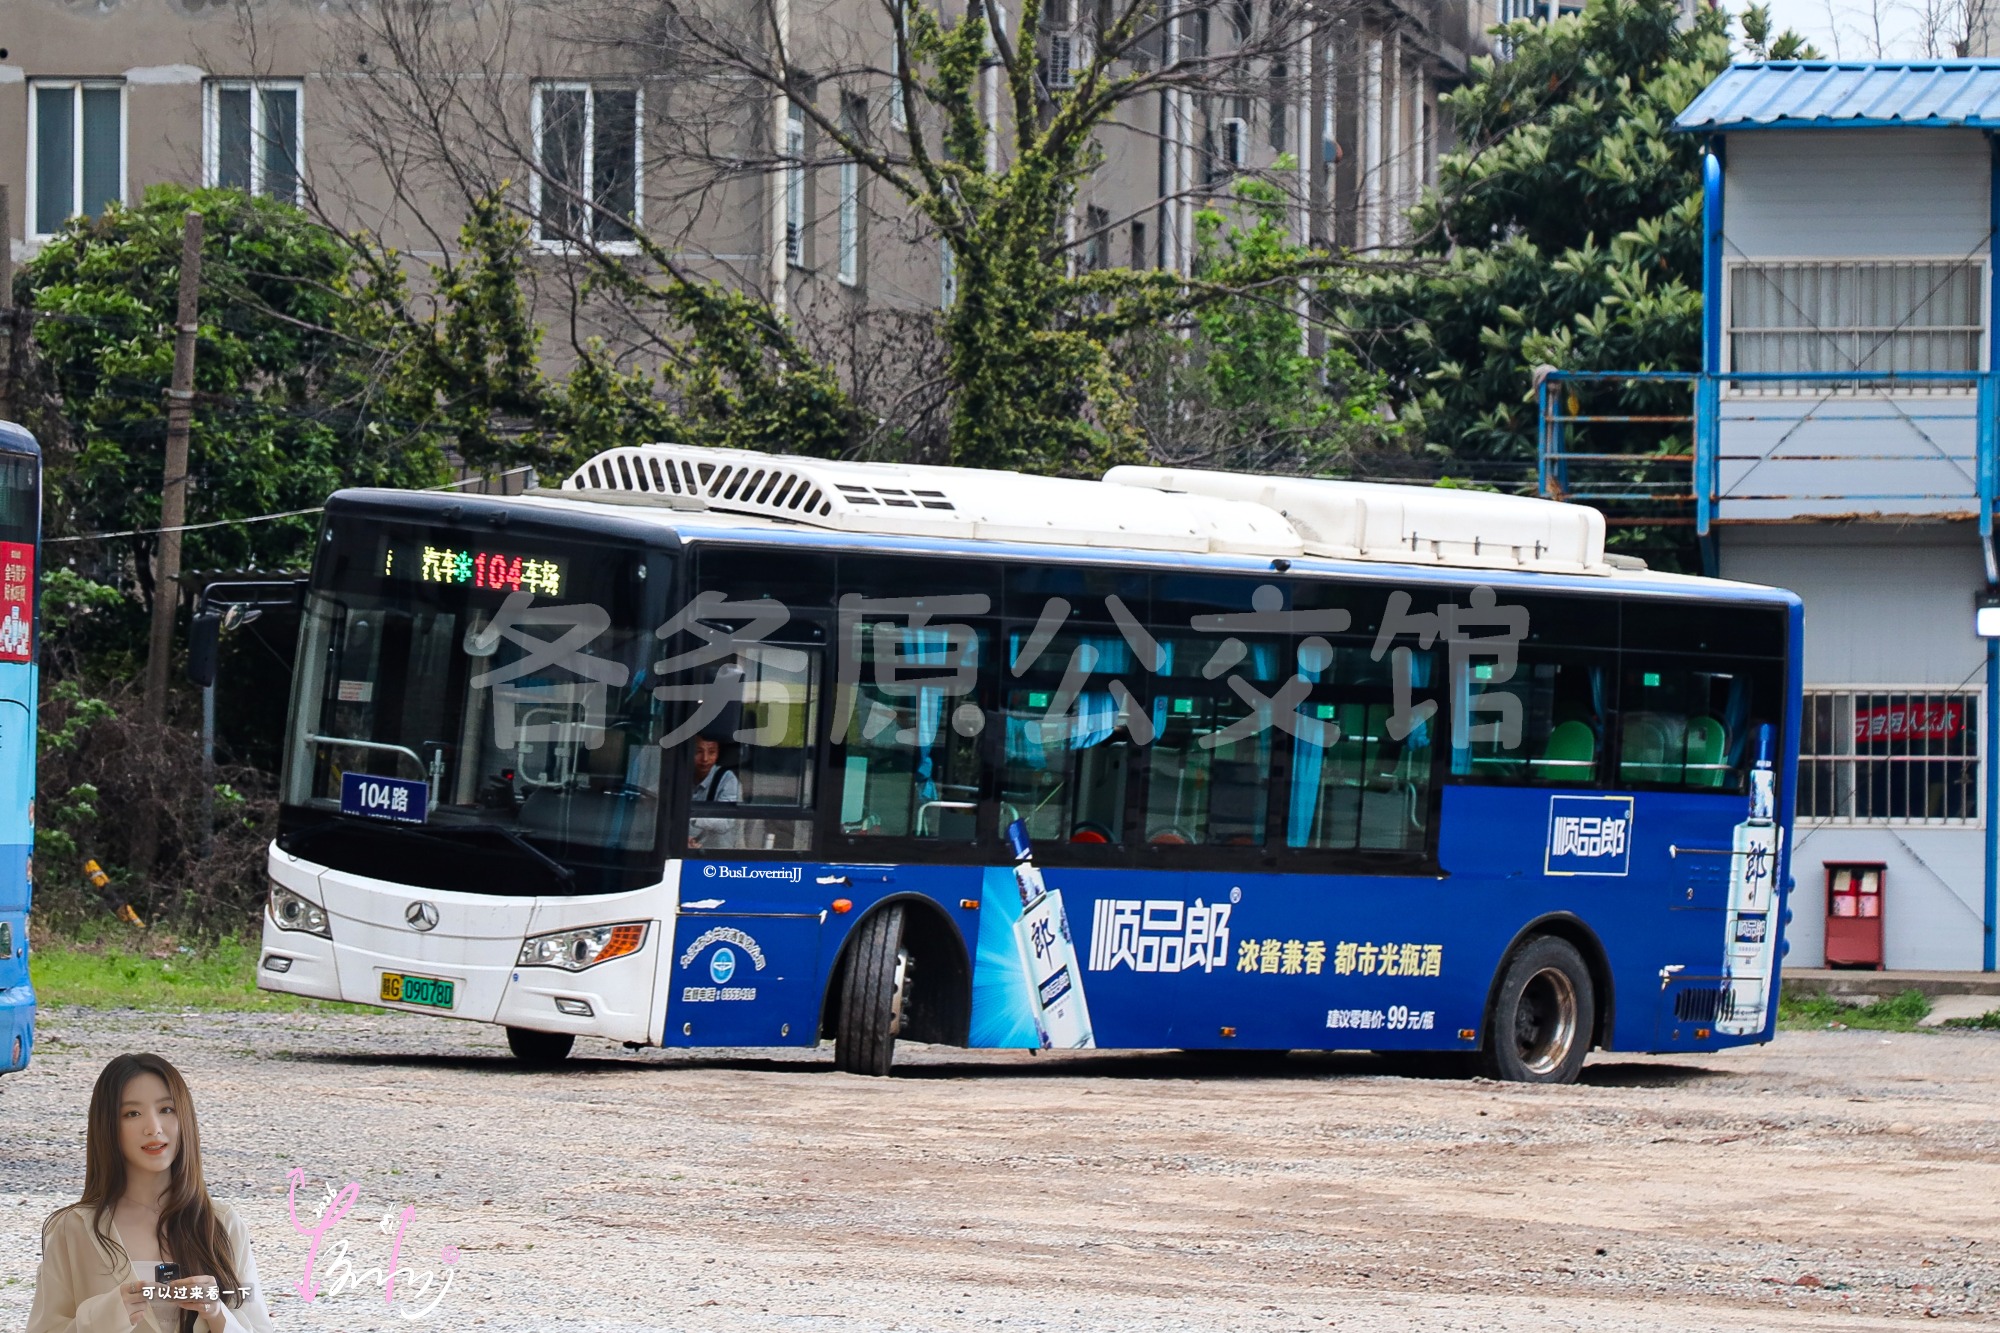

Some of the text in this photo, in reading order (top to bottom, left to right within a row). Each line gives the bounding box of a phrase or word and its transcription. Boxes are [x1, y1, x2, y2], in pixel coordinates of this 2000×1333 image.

[358, 781, 408, 812] 104路
[1552, 817, 1626, 858] 顺品郎
[1745, 841, 1768, 898] 郎
[1031, 918, 1055, 969] 郎
[1089, 898, 1230, 973] 顺品郎
[1237, 940, 1442, 977] 浓酱兼香 都市光瓶酒
